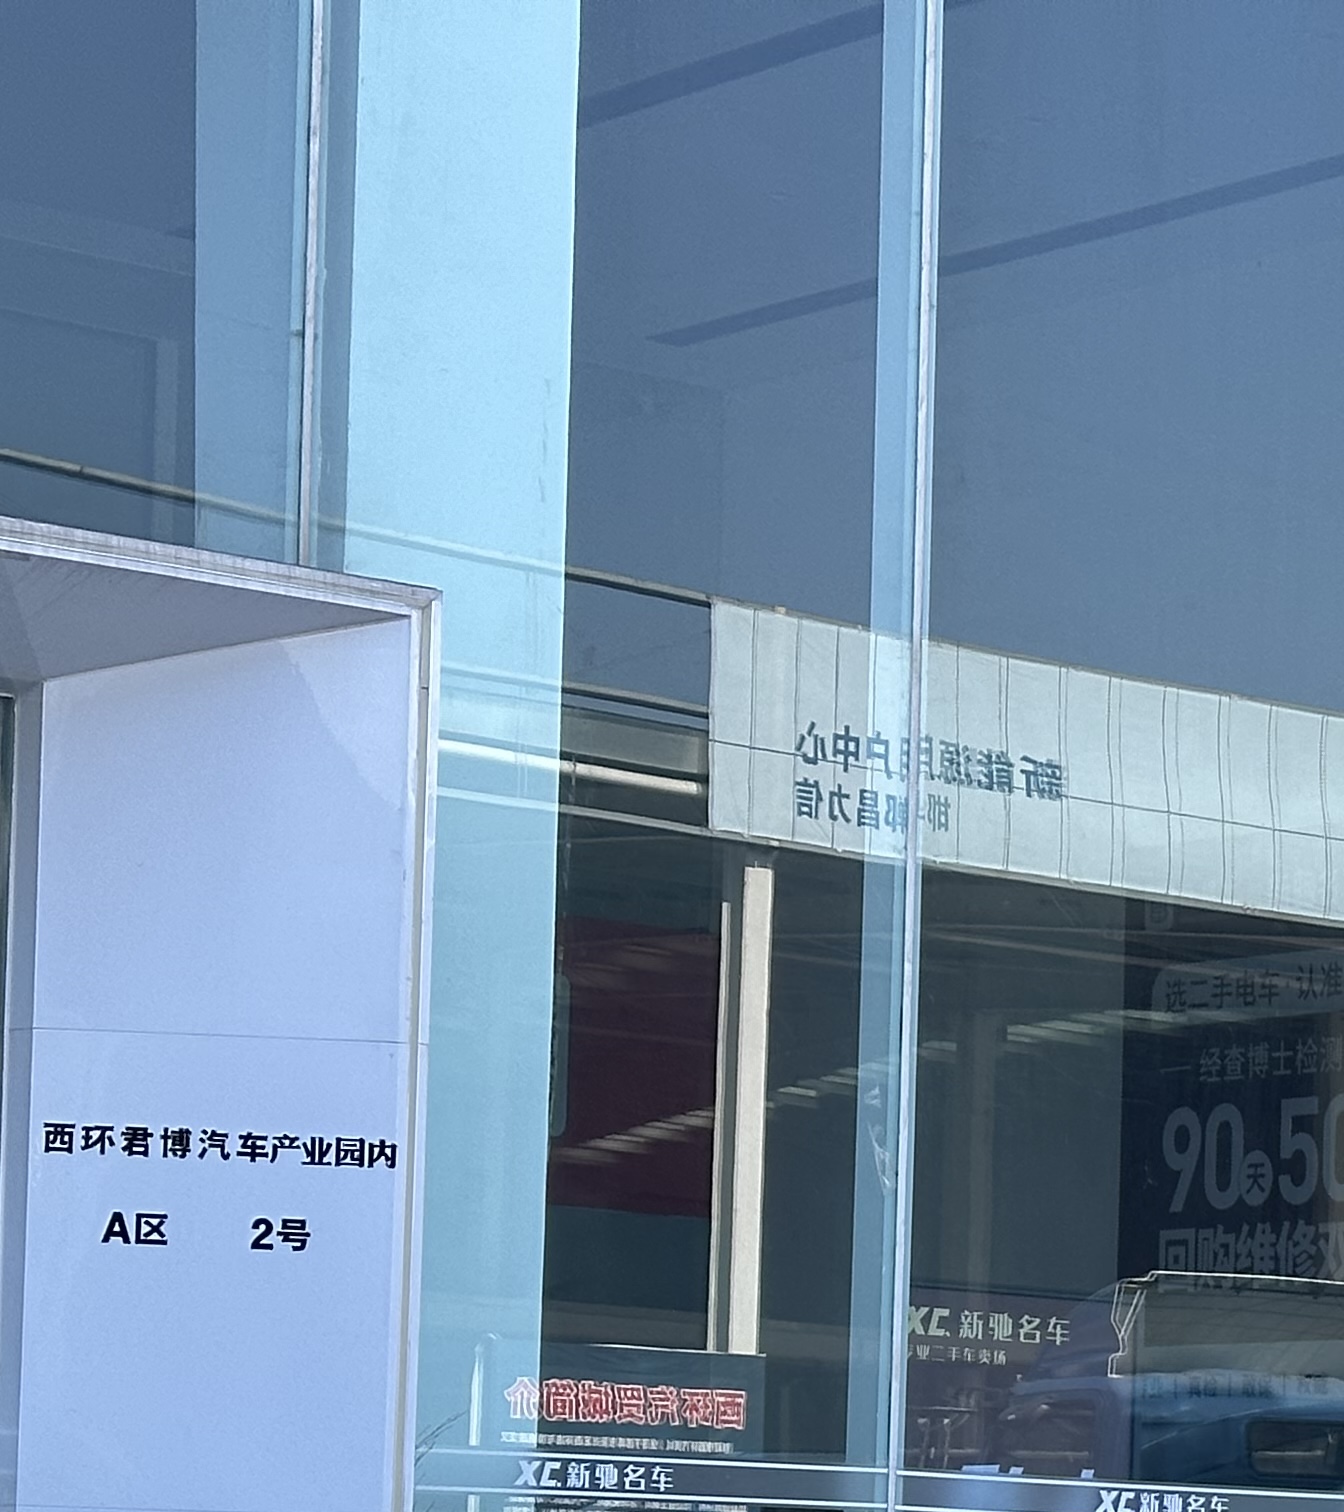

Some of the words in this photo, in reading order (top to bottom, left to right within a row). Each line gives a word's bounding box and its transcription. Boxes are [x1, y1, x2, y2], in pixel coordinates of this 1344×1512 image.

[43, 1122, 398, 1170] 西环君博汽车产业园内
[102, 1211, 168, 1246] A区
[251, 1217, 311, 1252] 2号
[959, 1310, 1070, 1345] 新驰名车
[566, 1462, 674, 1491] 新驰名车
